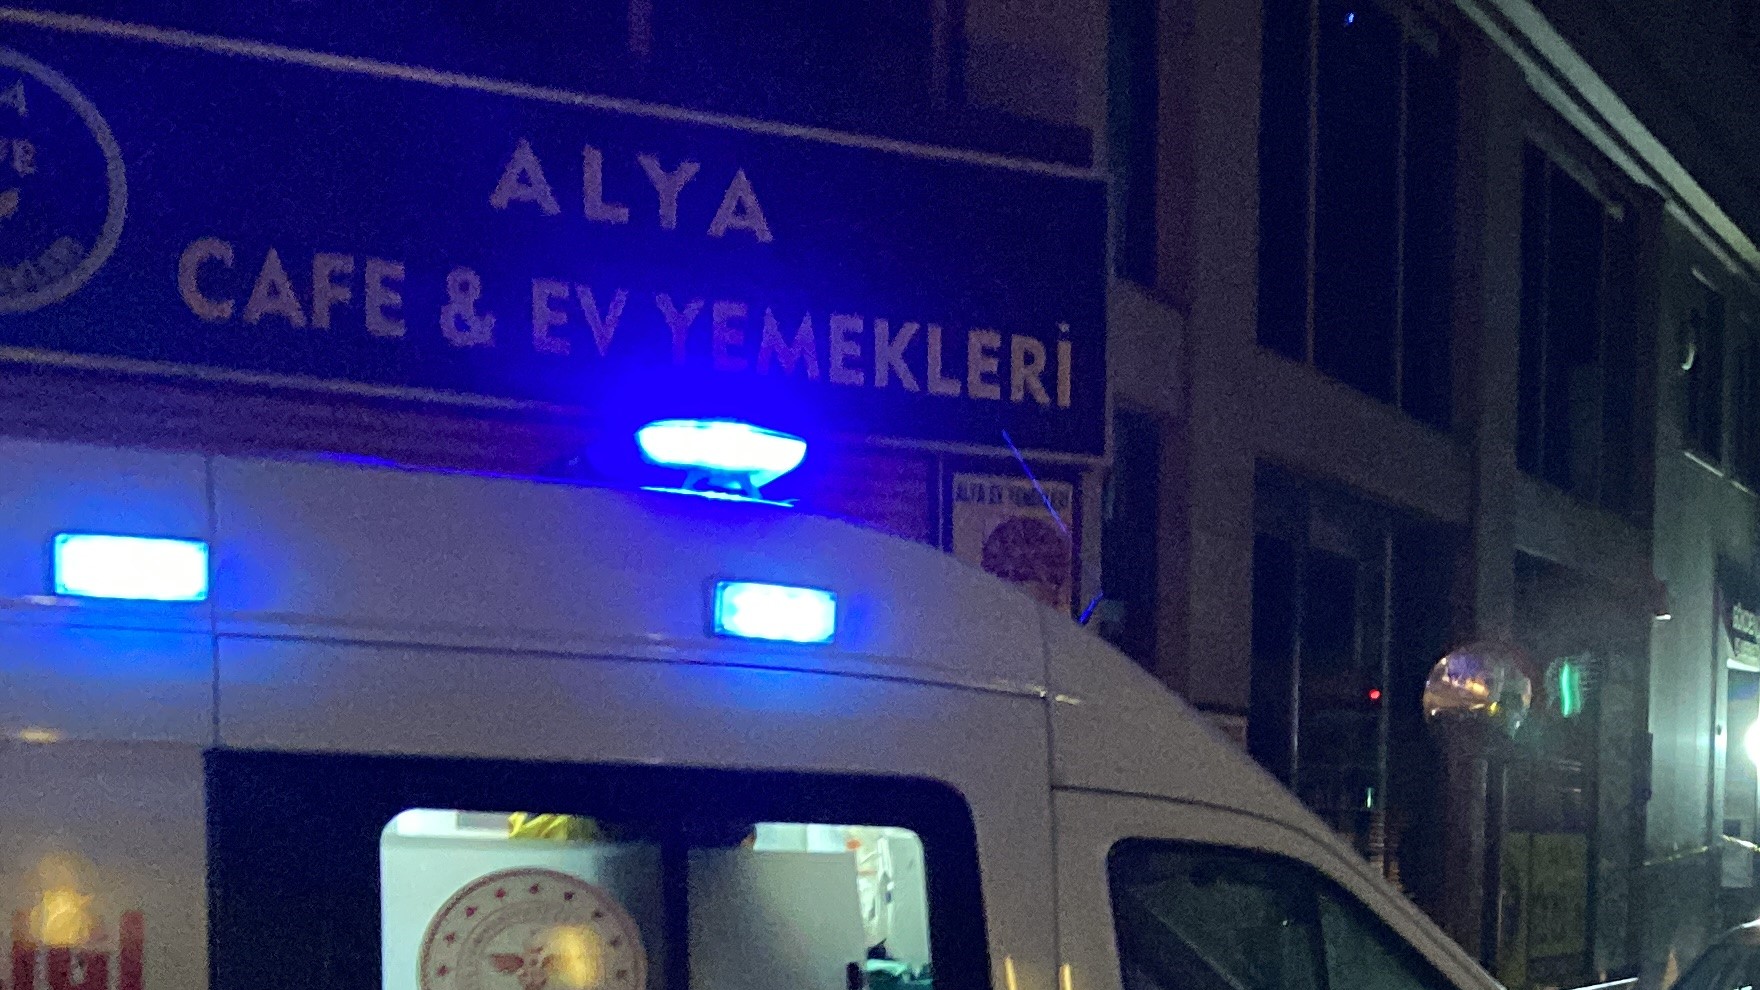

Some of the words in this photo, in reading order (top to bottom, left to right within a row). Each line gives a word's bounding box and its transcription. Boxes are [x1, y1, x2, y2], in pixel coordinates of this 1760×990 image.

[489, 137, 774, 243] ALYA
[178, 236, 406, 338] CAFE
[440, 266, 496, 347] &
[532, 277, 630, 356] EV
[655, 292, 1072, 409] YEMEKLERİ
